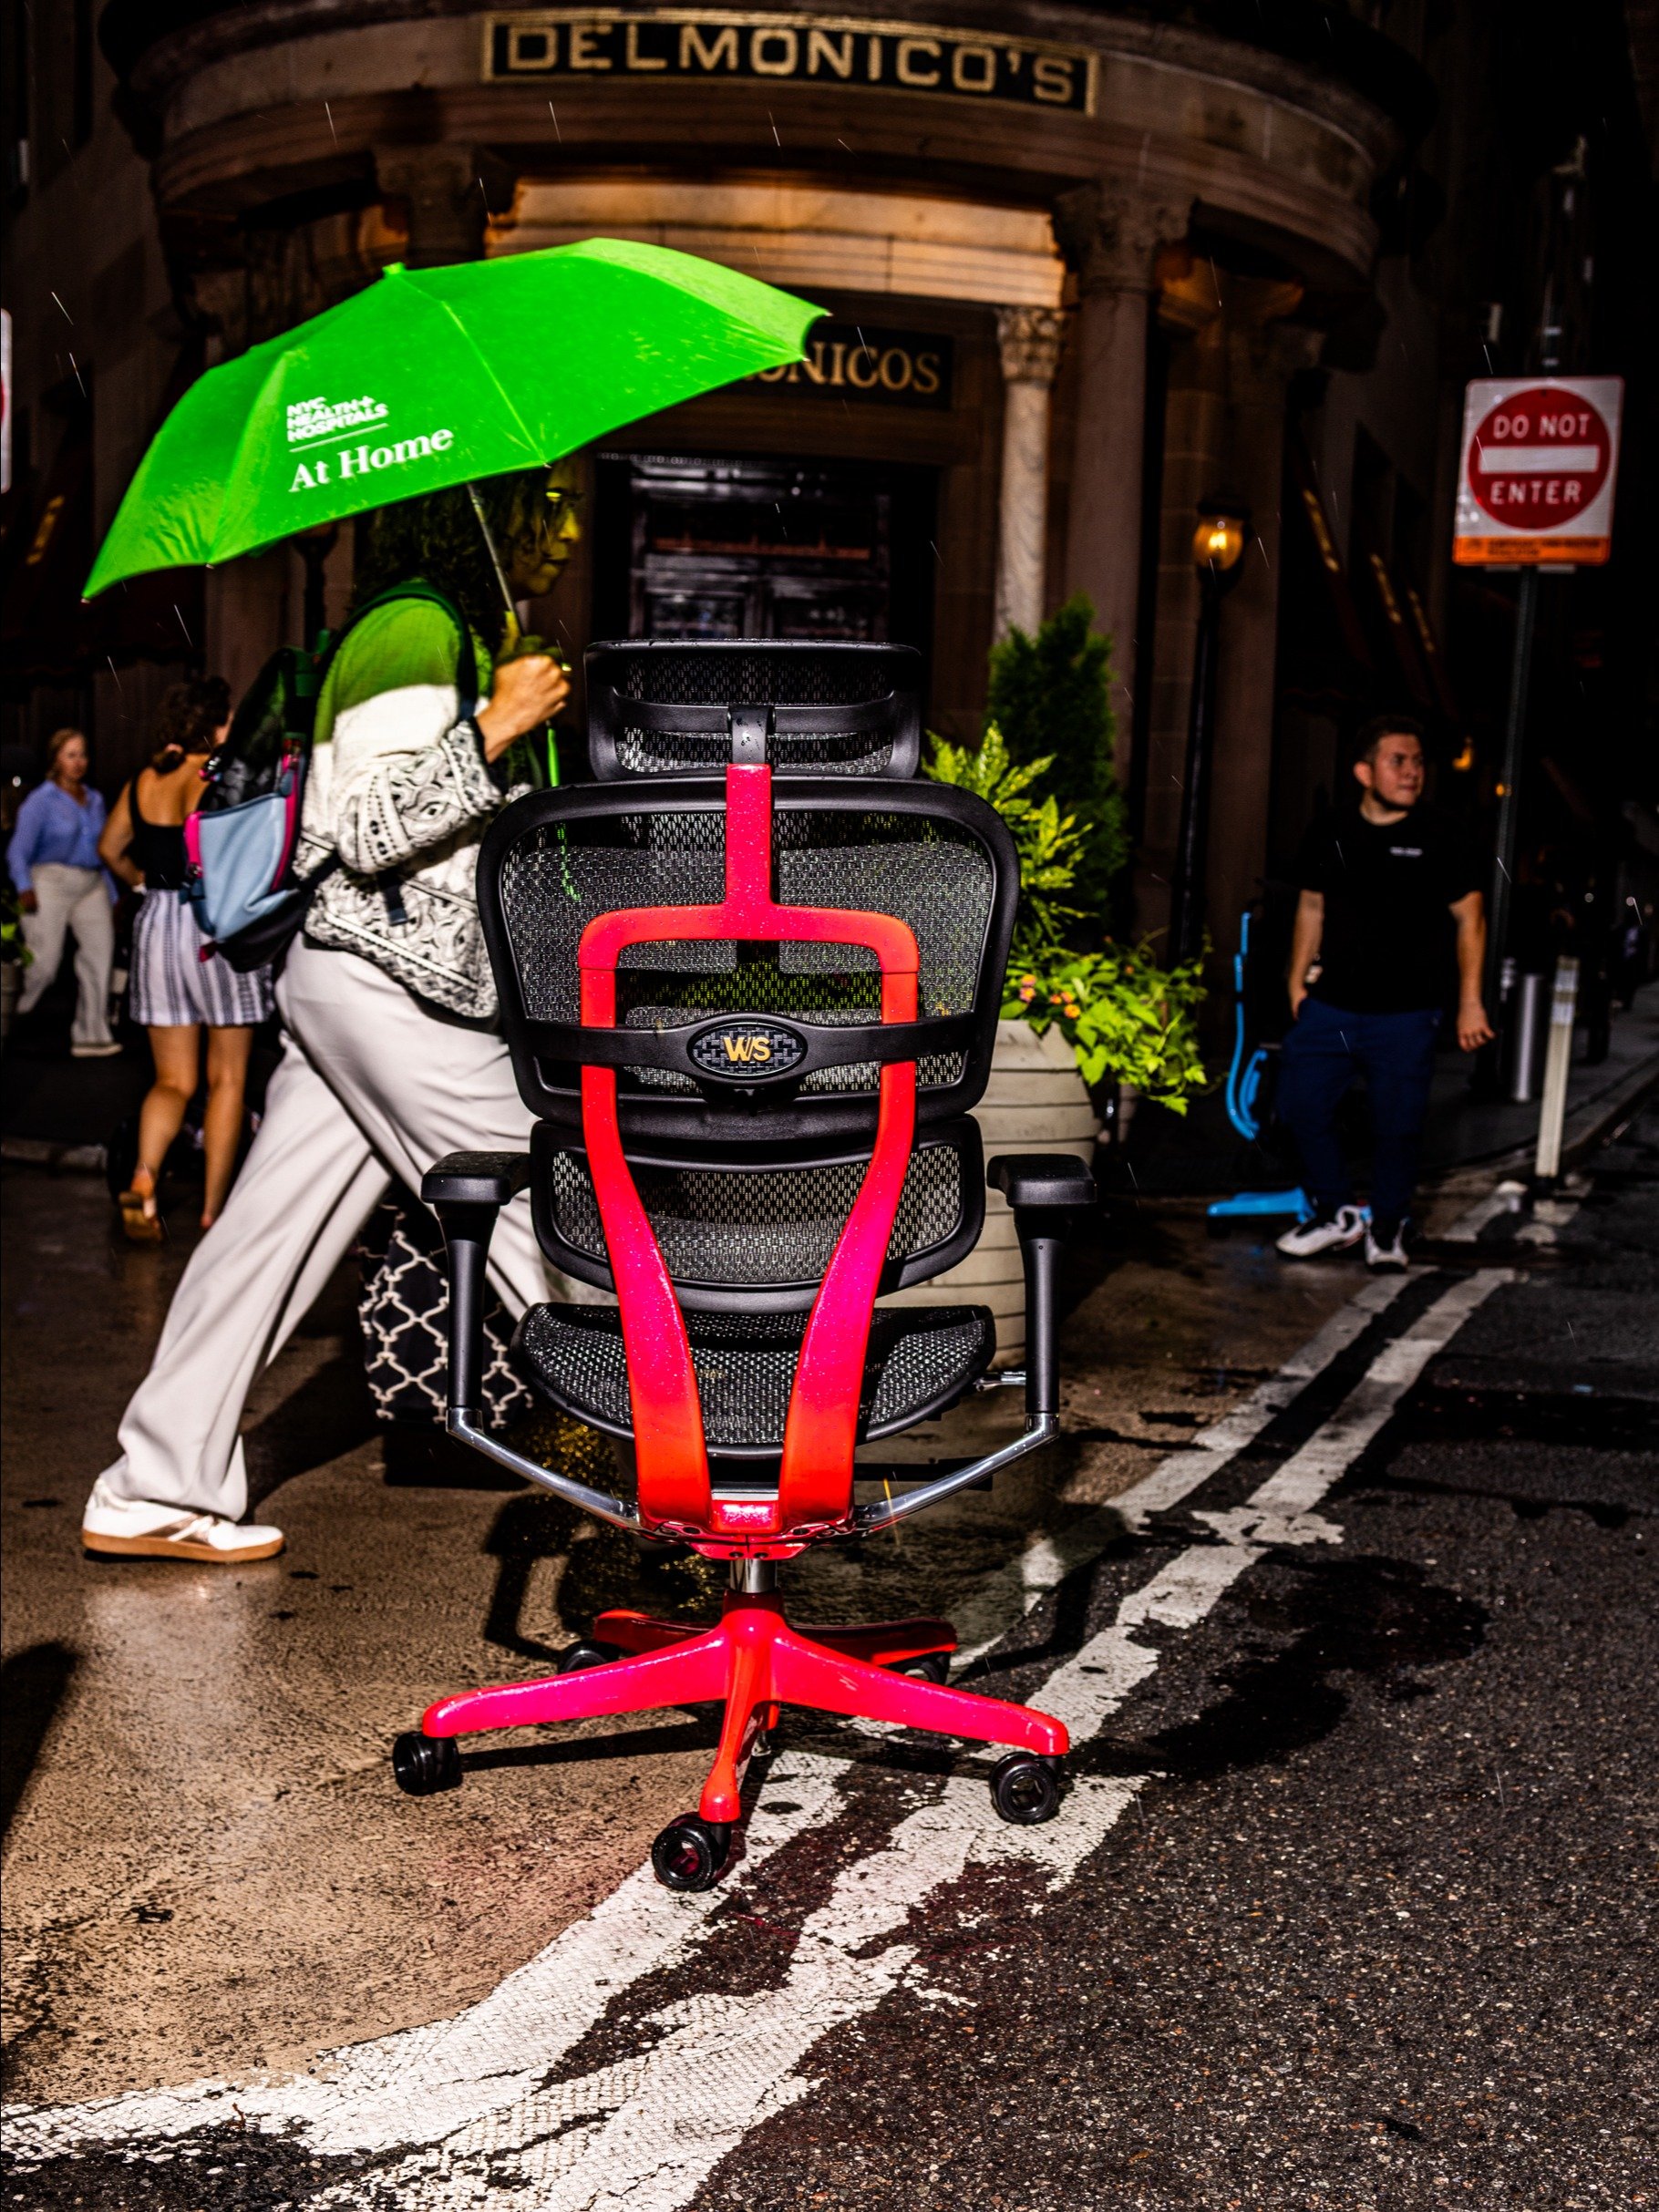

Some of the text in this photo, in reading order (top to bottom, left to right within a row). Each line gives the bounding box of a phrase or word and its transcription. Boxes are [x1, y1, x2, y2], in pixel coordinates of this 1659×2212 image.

[507, 25, 1075, 102] DELMONICO'S
[744, 340, 941, 394] NICOS
[287, 396, 326, 417] NYC
[287, 404, 389, 442] HOSPITALS
[1492, 413, 1591, 439] DO NOT
[288, 428, 455, 492] At Home
[1489, 479, 1582, 505] ENTER
